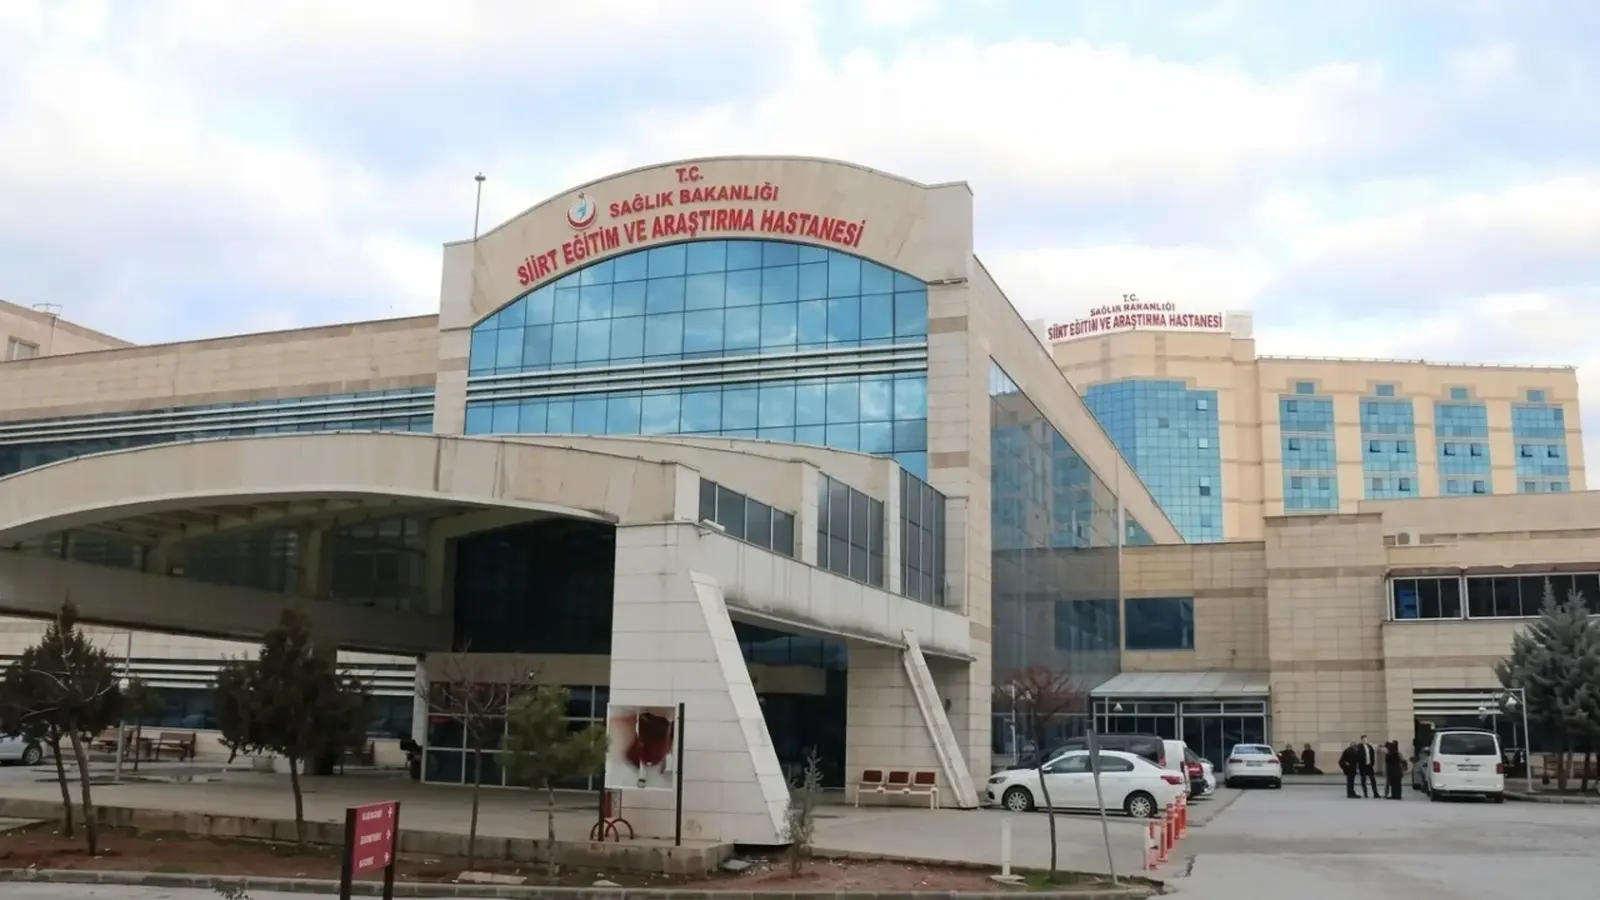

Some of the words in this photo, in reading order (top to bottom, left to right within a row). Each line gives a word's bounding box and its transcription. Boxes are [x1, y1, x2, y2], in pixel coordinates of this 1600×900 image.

[676, 166, 704, 183] T.C.
[609, 193, 674, 218] SAĞLIK
[679, 182, 779, 205] BAKANLIĞI
[517, 248, 558, 286] SİİRT
[562, 226, 620, 265] EĞİTİM
[623, 219, 648, 244] VE
[652, 208, 754, 237] ARAŞTIRMA
[760, 209, 866, 248] HASTANESİ
[1100, 316, 1111, 329] VE
